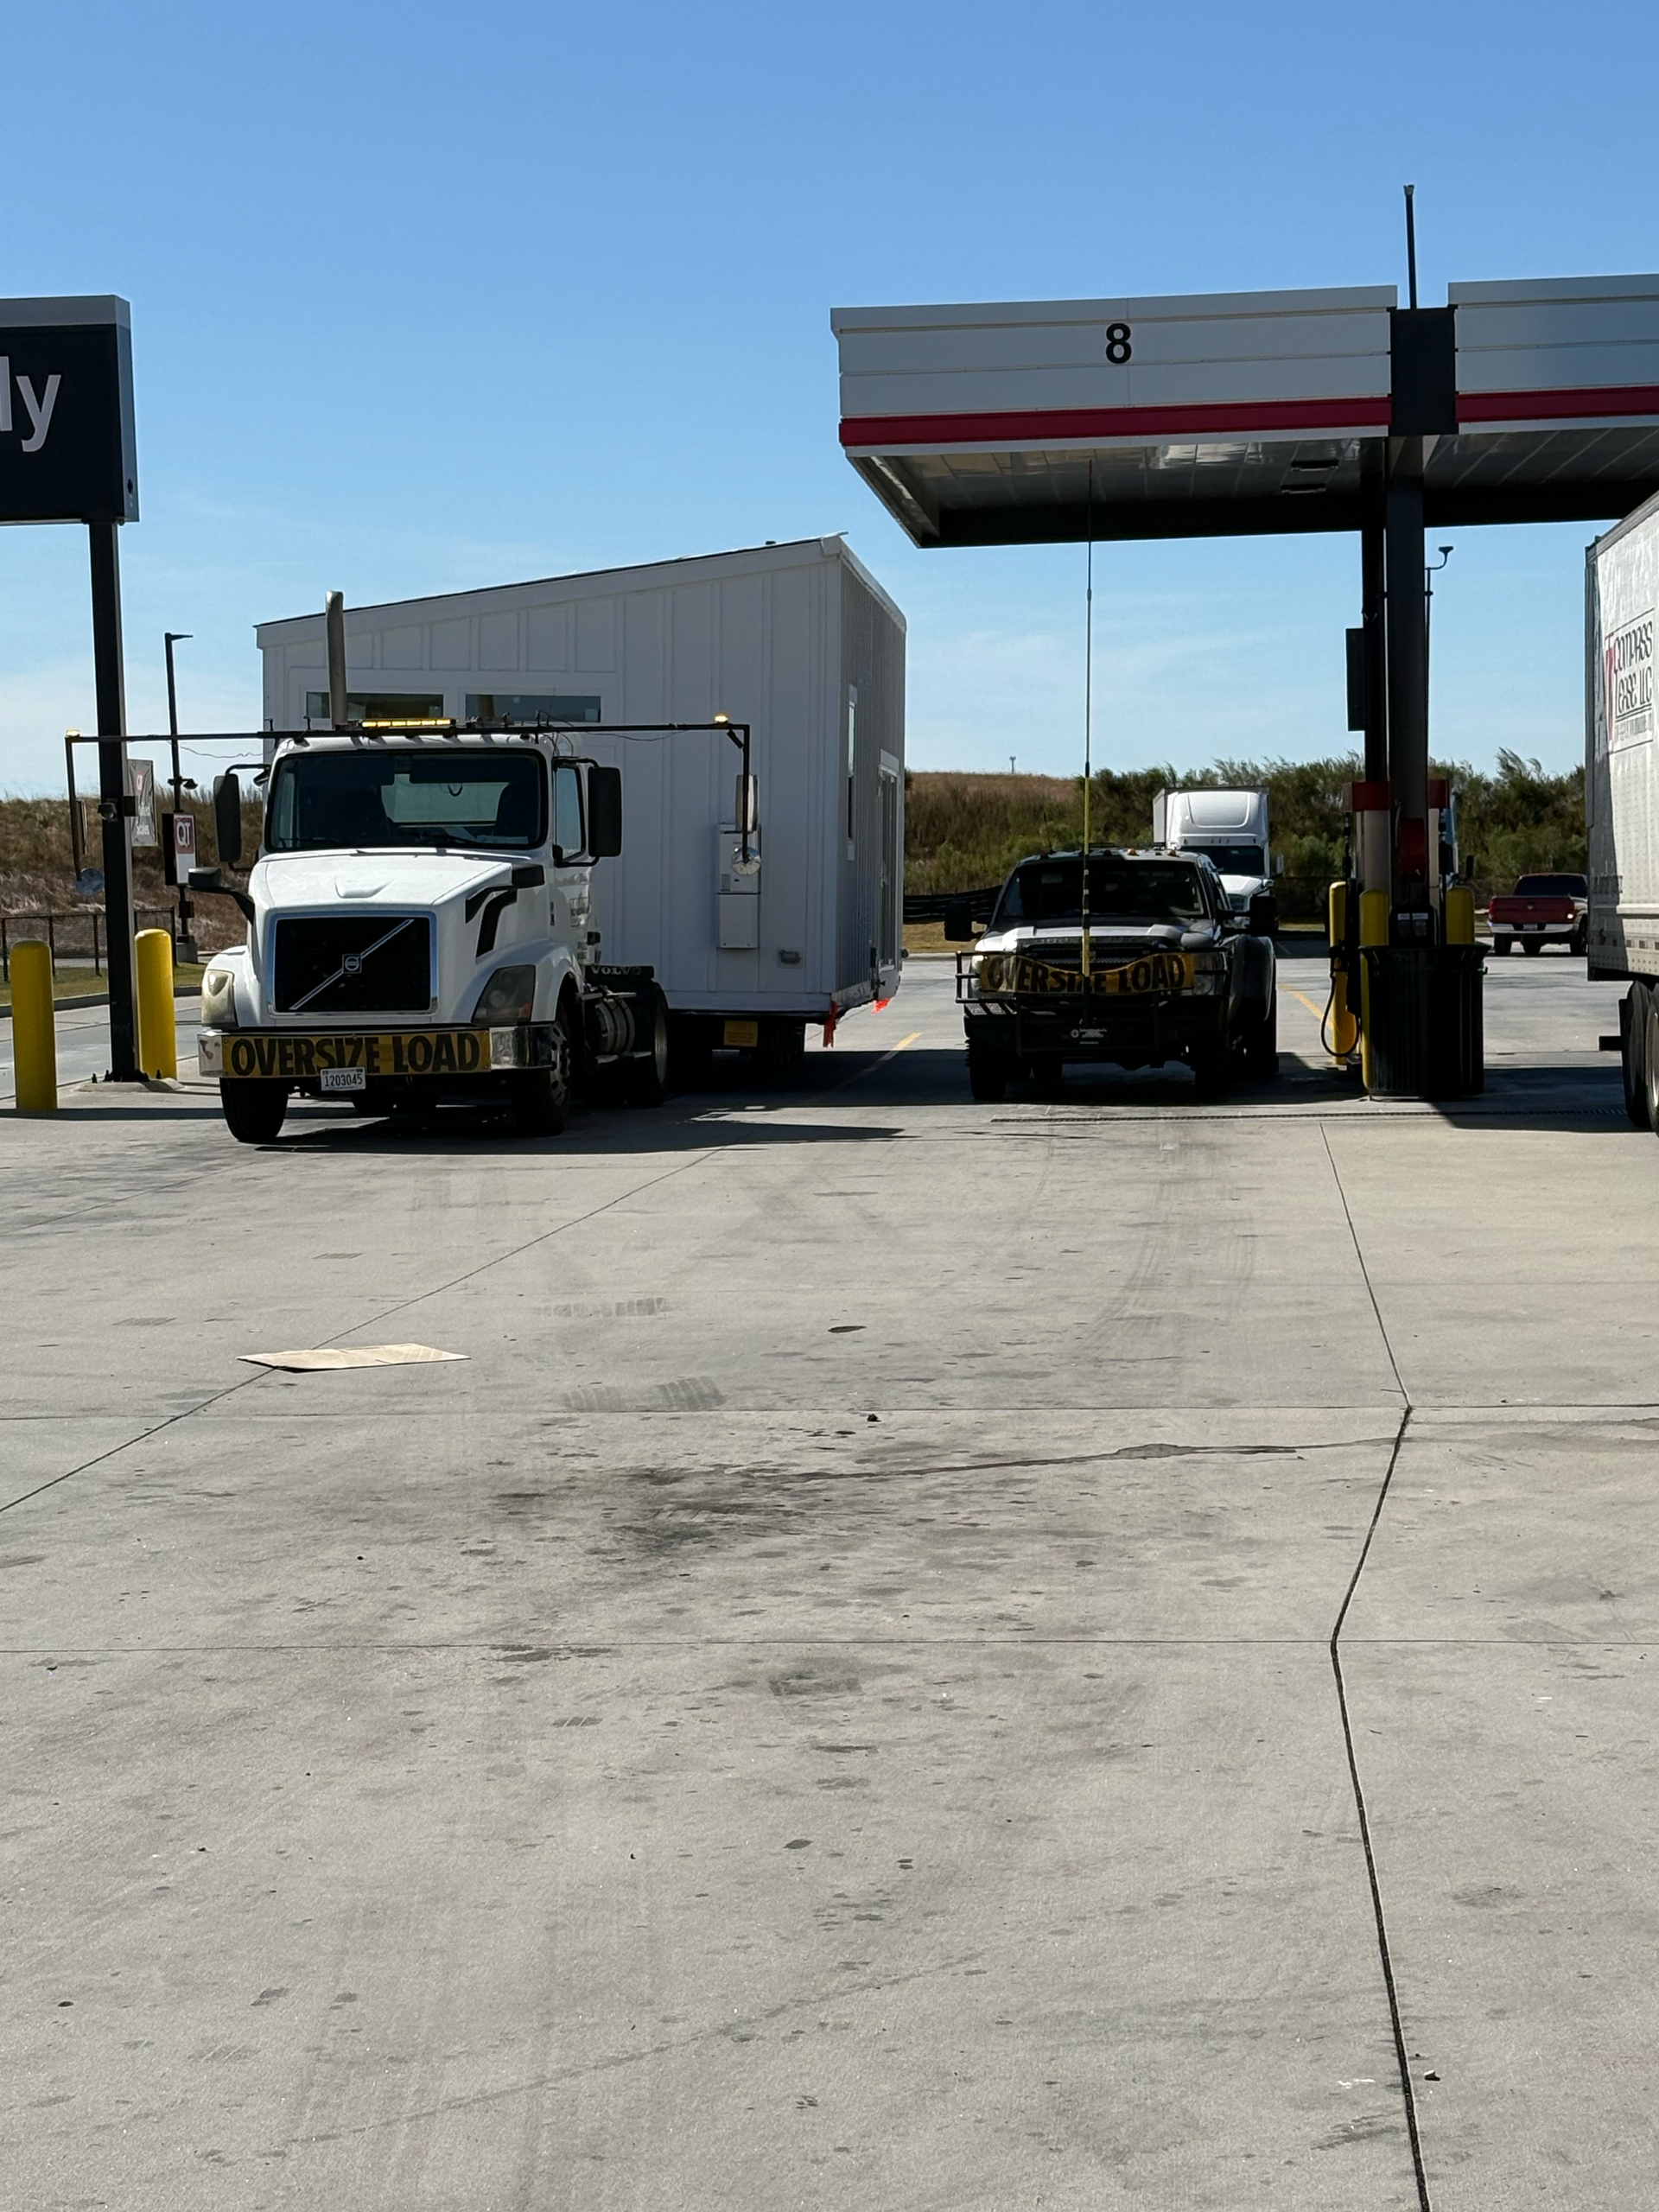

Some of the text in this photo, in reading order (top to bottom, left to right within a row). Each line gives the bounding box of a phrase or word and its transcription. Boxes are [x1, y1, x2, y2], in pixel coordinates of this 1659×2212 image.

[1105, 322, 1132, 365] 8
[0, 355, 62, 453] ly
[1613, 620, 1652, 673] COMPASS
[1639, 665, 1652, 706] LLC
[176, 821, 191, 849] QT
[590, 965, 642, 976] VOLVO
[1119, 954, 1185, 992] LOAD
[231, 1032, 480, 1077] OVERSIZE LOAD
[324, 1073, 363, 1087] 1203045
